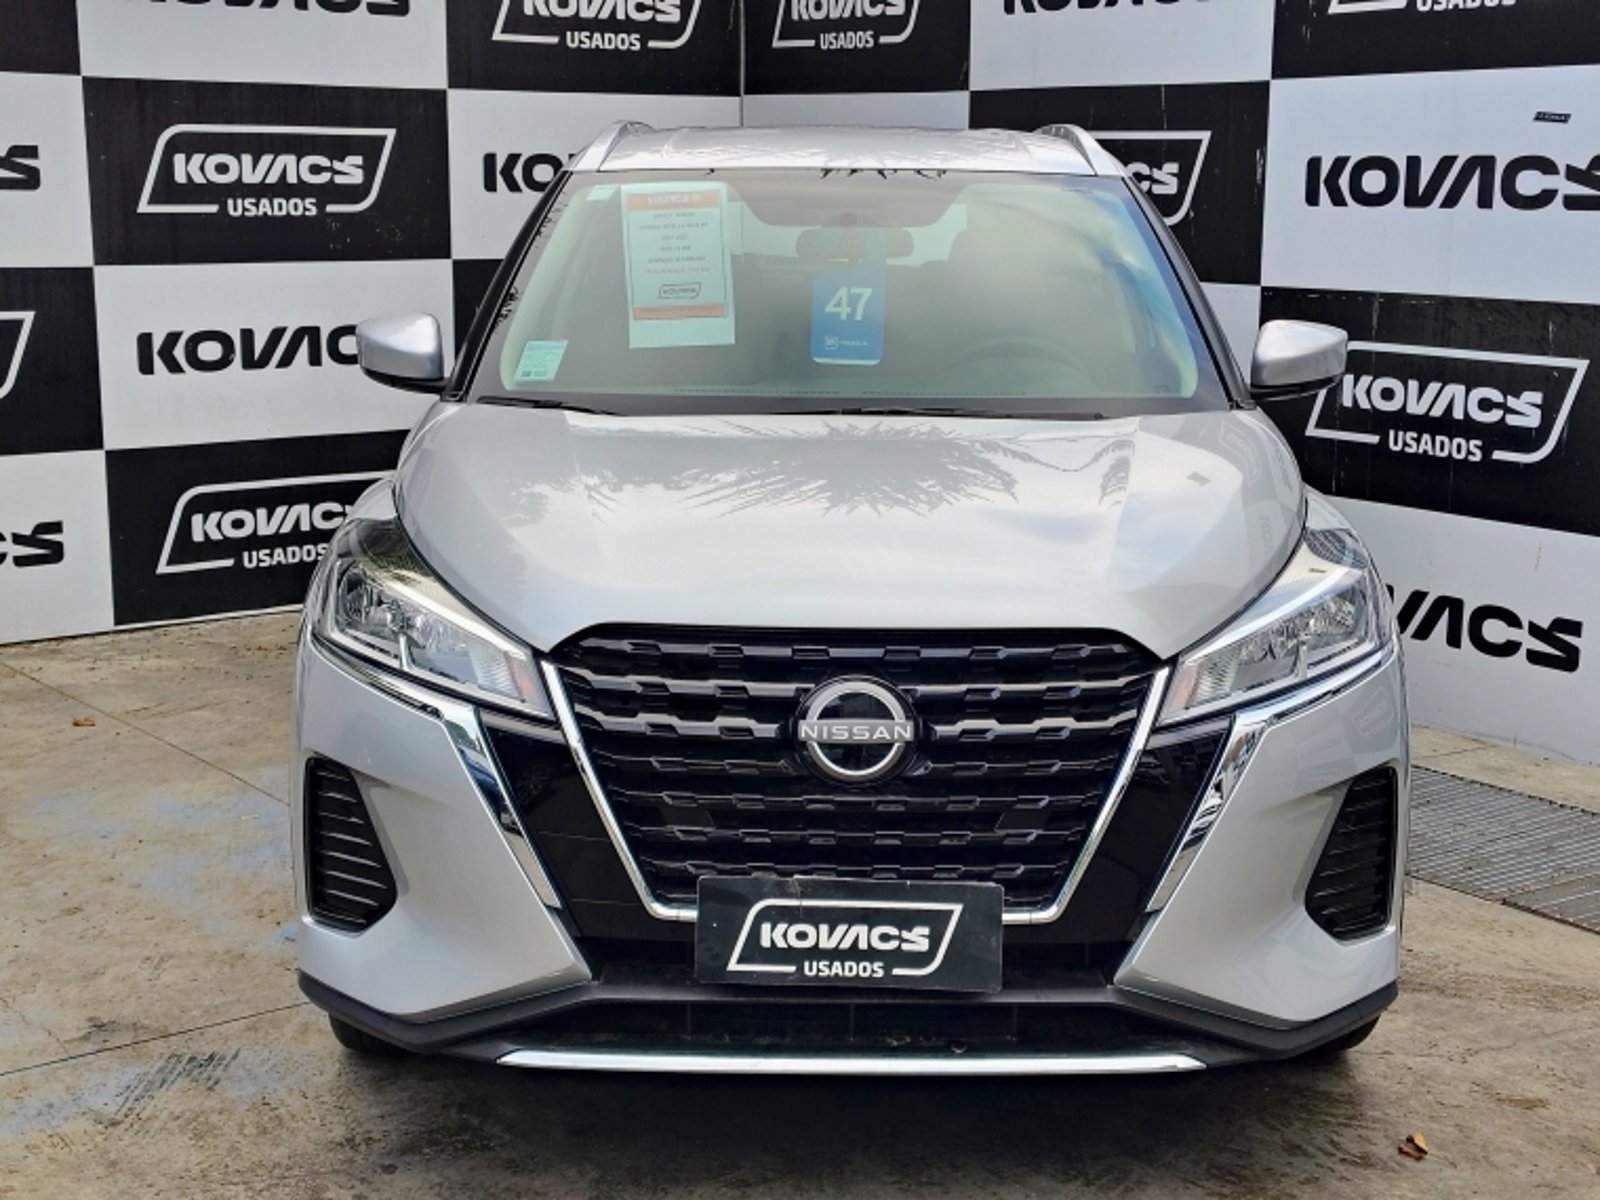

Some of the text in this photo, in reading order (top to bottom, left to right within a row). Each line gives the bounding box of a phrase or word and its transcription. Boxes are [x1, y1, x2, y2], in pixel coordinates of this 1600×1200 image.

[565, 31, 641, 50] USADOS
[820, 31, 874, 49] USADOS
[173, 153, 363, 184] KOVACS
[227, 197, 317, 217] USADOS
[824, 286, 872, 321] 47
[136, 324, 360, 375] KOVAC
[1342, 374, 1544, 429] KOVACS
[1388, 429, 1482, 462] USADOS
[191, 501, 354, 542] KOVAC
[1385, 583, 1583, 674] VACS
[800, 723, 912, 740] NISSAN
[759, 921, 931, 953] KOVACS
[803, 960, 885, 978] USADOS
